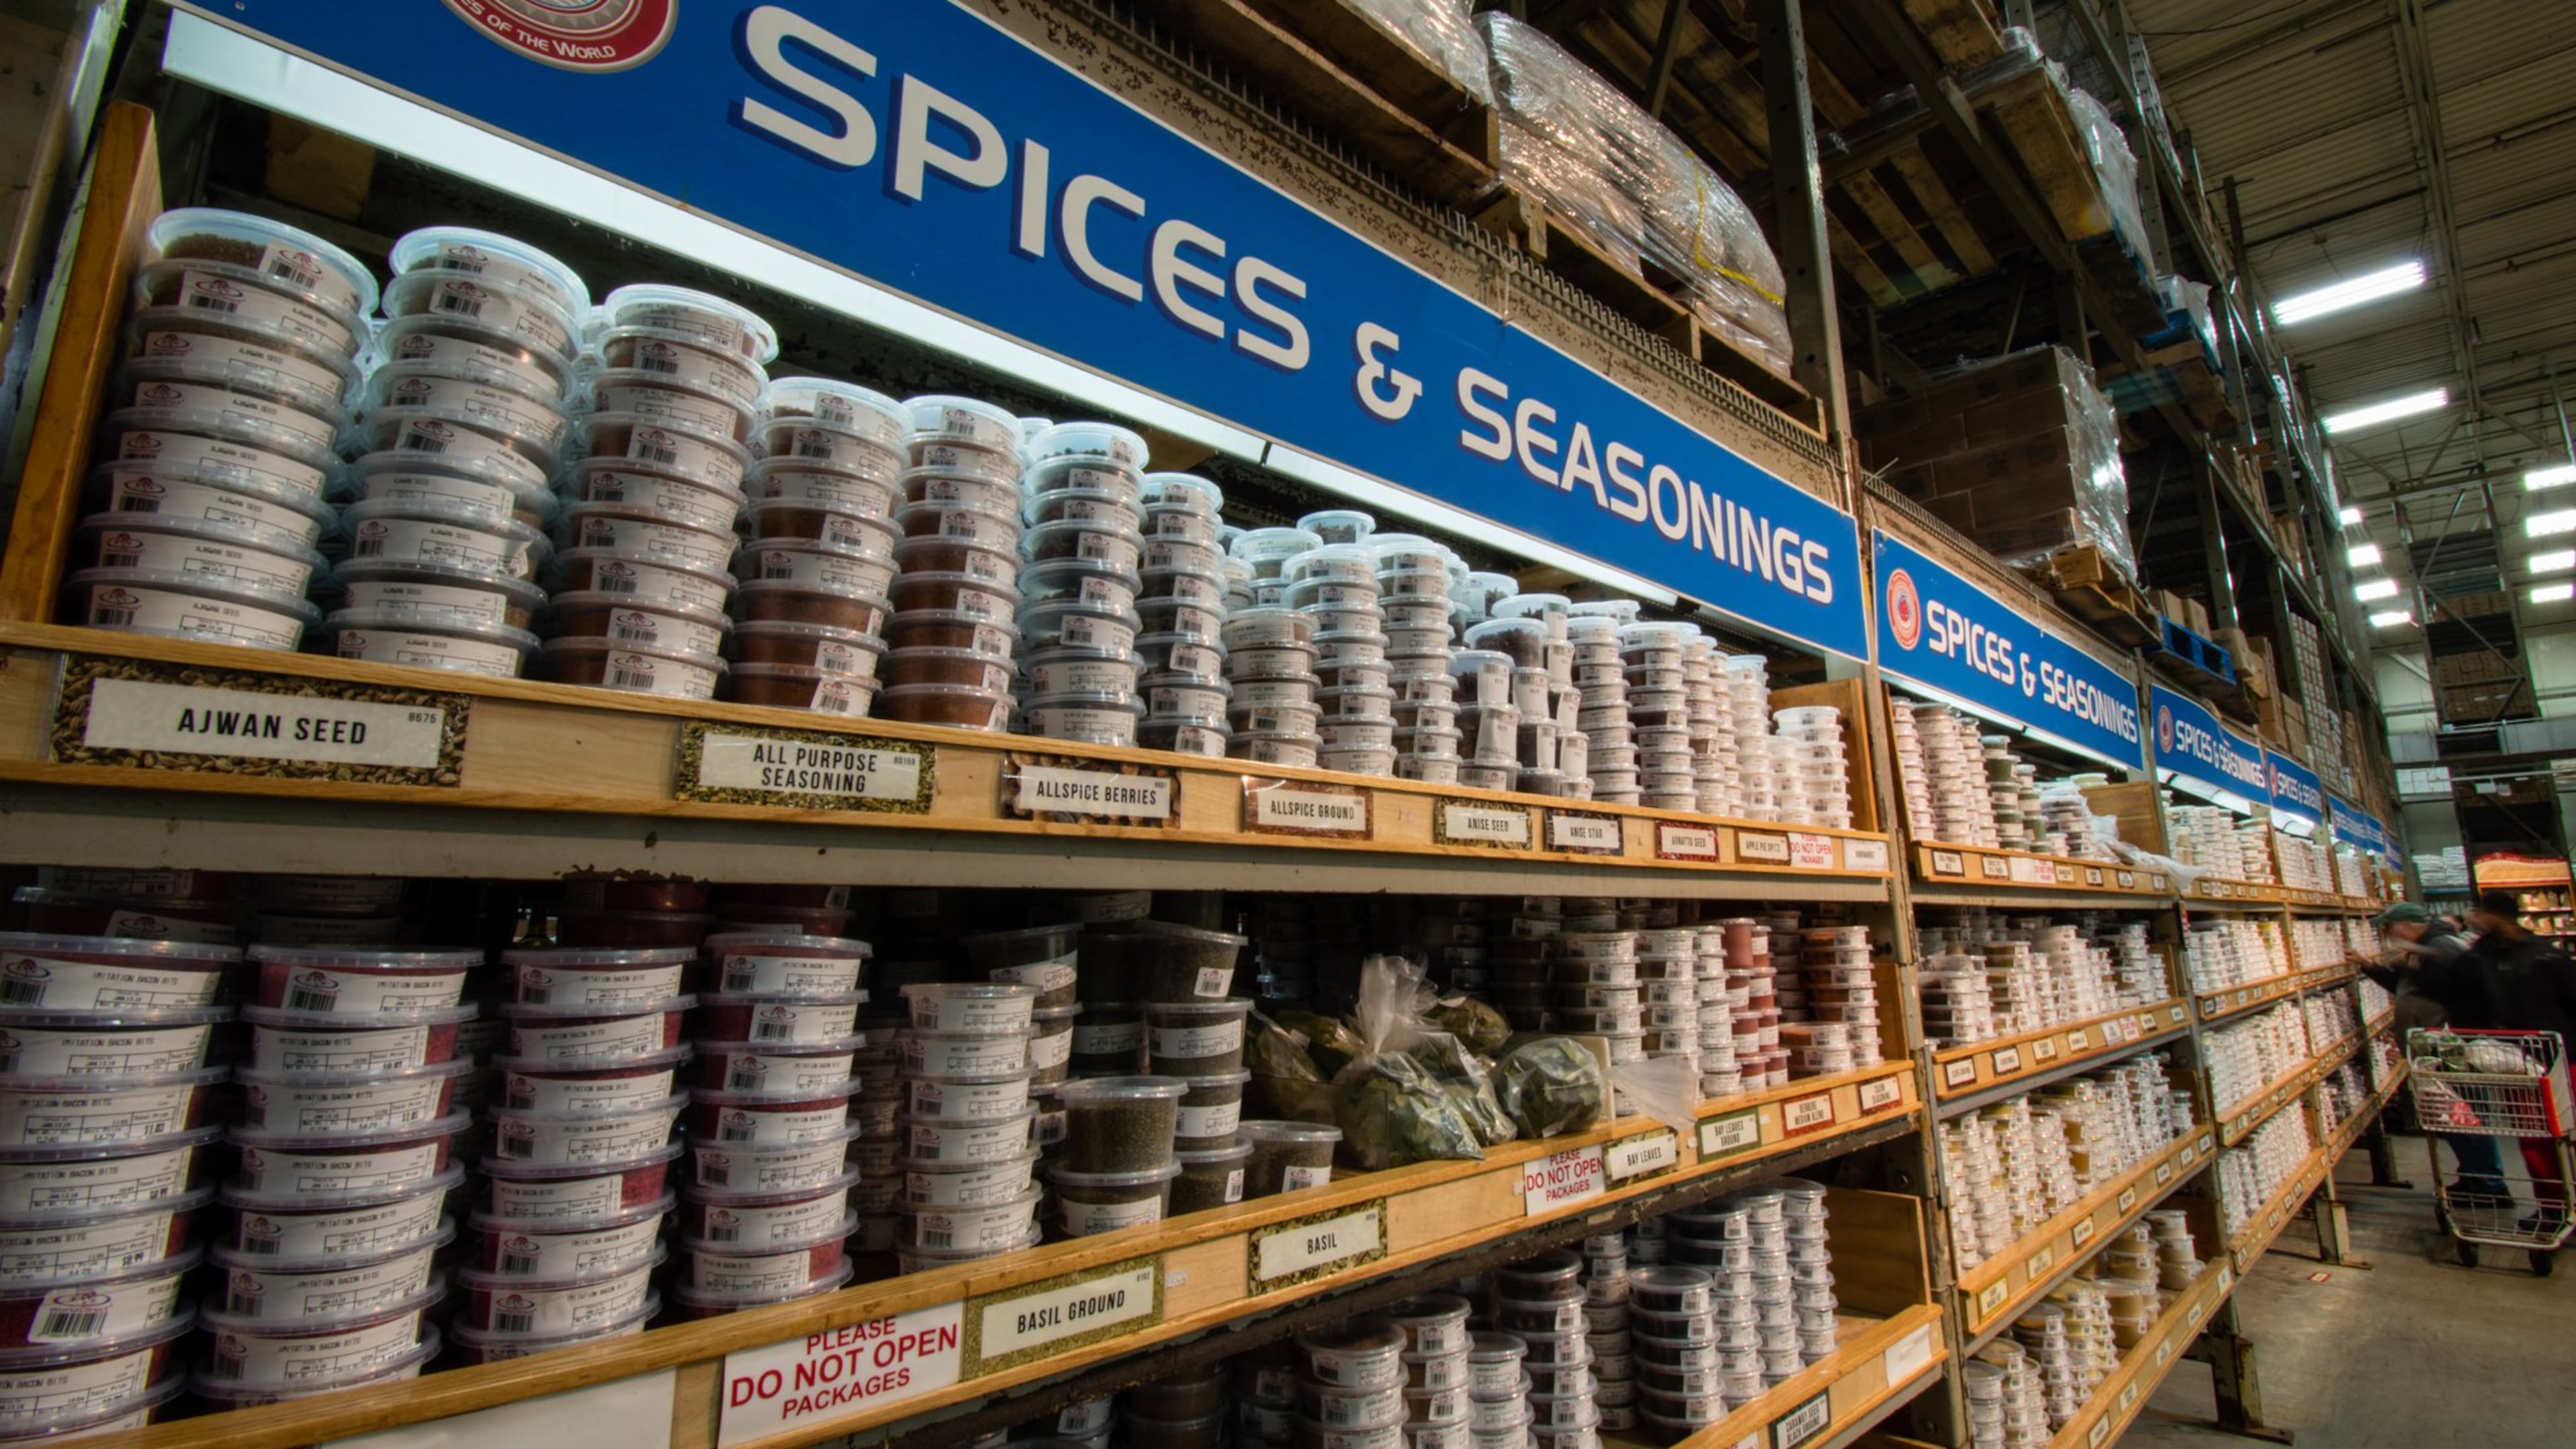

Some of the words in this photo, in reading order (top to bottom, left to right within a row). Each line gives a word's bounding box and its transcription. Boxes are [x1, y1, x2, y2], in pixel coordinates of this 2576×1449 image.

[486, 15, 513, 33] OF
[517, 29, 549, 52] THE
[552, 39, 616, 60] WORLD
[738, 4, 1311, 373] SPICES
[1354, 321, 1423, 421] &
[1457, 366, 1834, 606] SEASONINGS
[1926, 599, 2015, 686] SPICES
[2019, 651, 2037, 698] &
[2040, 660, 2139, 744] SEASONINGS
[177, 707, 282, 739] AJWAN
[294, 717, 367, 746] SEED
[407, 711, 437, 725] 8675
[2175, 719, 2213, 764] SPICES
[753, 743, 790, 764] ALL
[796, 748, 878, 773] PURPOSE
[761, 767, 867, 793] SEASONING
[1036, 780, 1099, 801] ALLSPICE
[1104, 784, 1157, 806] BERRIES
[1270, 799, 1315, 818] ALLSPICE
[1317, 802, 1355, 820] GROUND
[1467, 816, 1490, 832] ANISE
[1491, 818, 1509, 833] SEED
[1570, 825, 1585, 839] ANISE
[1586, 826, 1603, 839] STAR
[1790, 843, 1801, 853] DO
[1801, 843, 1815, 853] NOT
[1815, 843, 1833, 855] OPEN
[93, 971, 134, 983] IMITATION
[136, 973, 160, 985] BACON
[1713, 1124, 1724, 1137] BAY
[1725, 1120, 1744, 1134] LEAVES
[1549, 1148, 1582, 1167] PLEASE
[1627, 1151, 1638, 1167] BAY
[1639, 1146, 1662, 1165] LEAVES
[1525, 1172, 1545, 1191] DO
[1545, 1164, 1571, 1187] NOT
[1573, 1157, 1605, 1180] OPEN
[1545, 1178, 1591, 1201] PACKAGES
[1306, 1233, 1338, 1256] BASIL
[1016, 1305, 1062, 1335] BASIL
[1067, 1289, 1126, 1320] GROUND
[806, 1315, 898, 1356] PLEASE
[729, 1369, 784, 1408] DO
[793, 1348, 861, 1393] NOT
[872, 1322, 959, 1371] OPEN
[781, 1366, 911, 1420] PACKAGES
